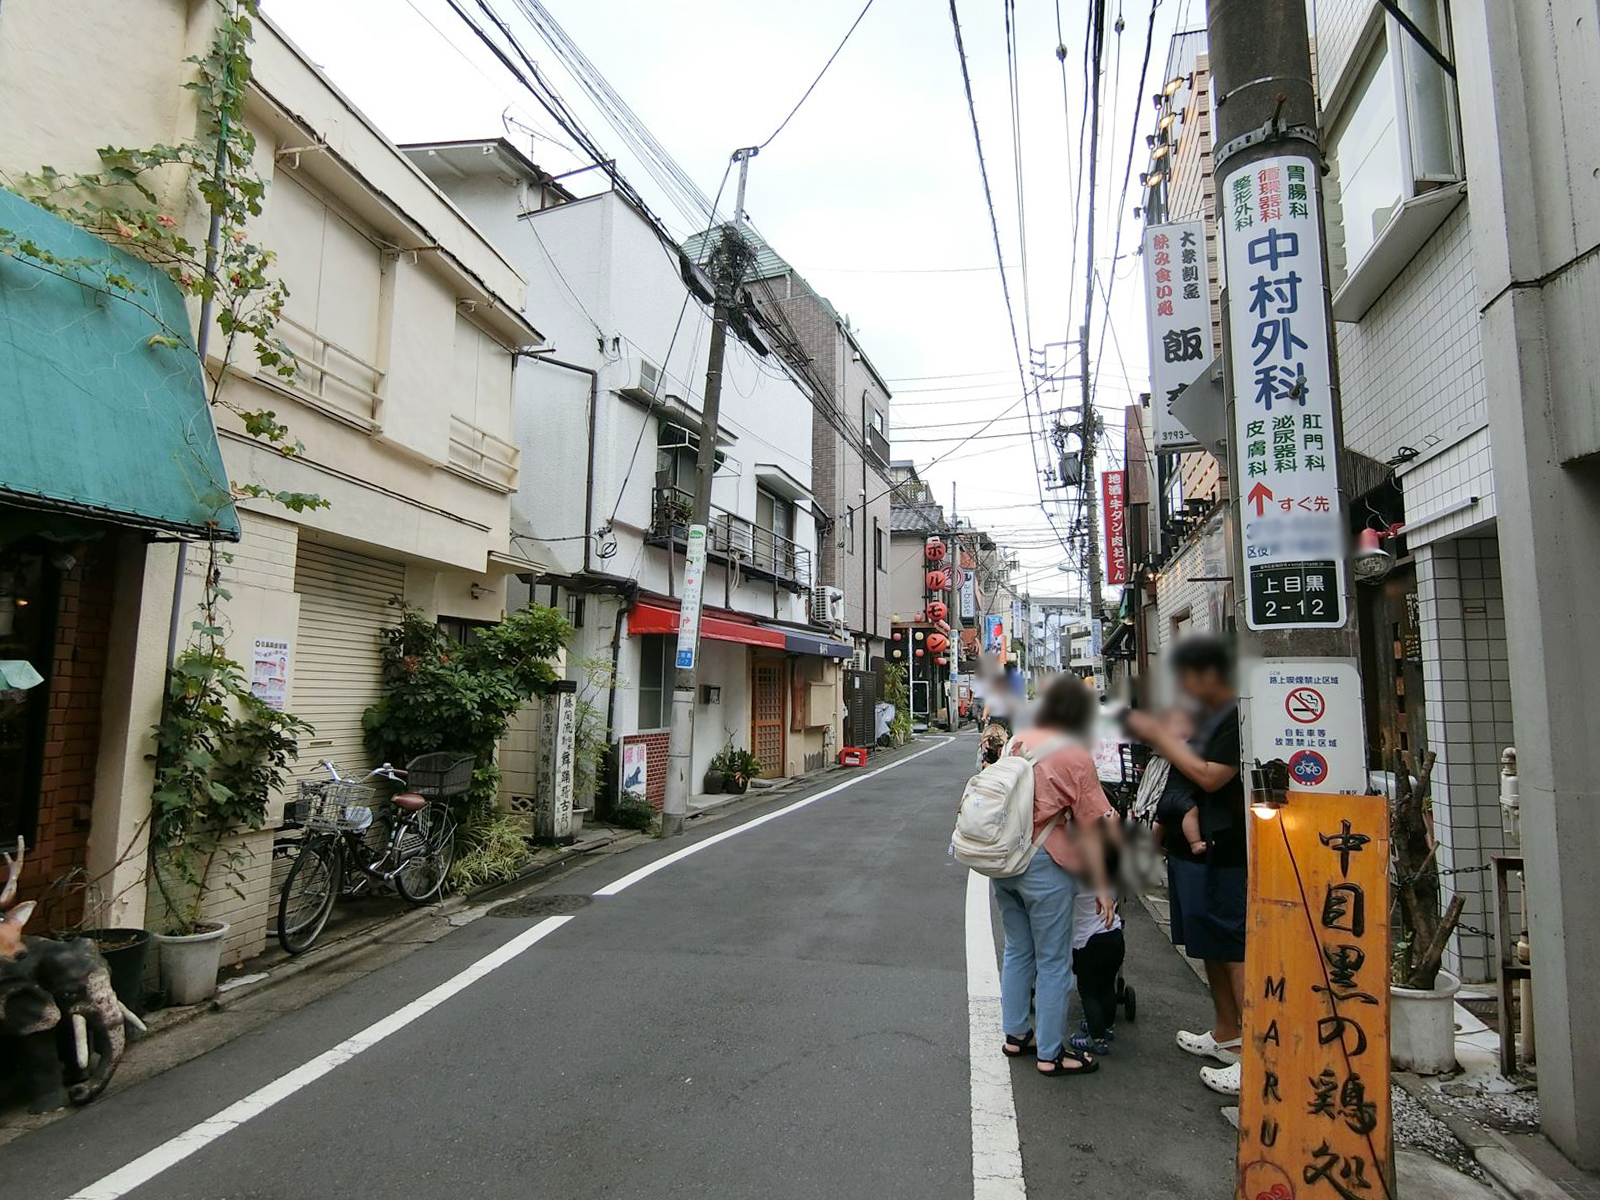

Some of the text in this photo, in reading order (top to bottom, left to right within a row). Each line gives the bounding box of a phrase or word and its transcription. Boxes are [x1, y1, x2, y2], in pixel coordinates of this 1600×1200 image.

[1232, 174, 1254, 232] 整形外科
[1257, 166, 1283, 222] 循環器科
[1287, 164, 1309, 219] 胃腸科
[1248, 227, 1309, 411] 中村外科
[1246, 420, 1268, 477] 皮膚科
[1272, 415, 1298, 474] 泌尿器科
[1302, 413, 1326, 472] 肛門科
[1278, 495, 1330, 513] すぐ先
[1263, 575, 1325, 594] 上目黒
[1265, 599, 1325, 617] 2-12
[1270, 676, 1339, 685] 路上喫煙禁止区域
[1275, 738, 1338, 748] 放置禁止区域
[1285, 729, 1327, 738] 自転車等
[1260, 975, 1286, 1147] MARU
